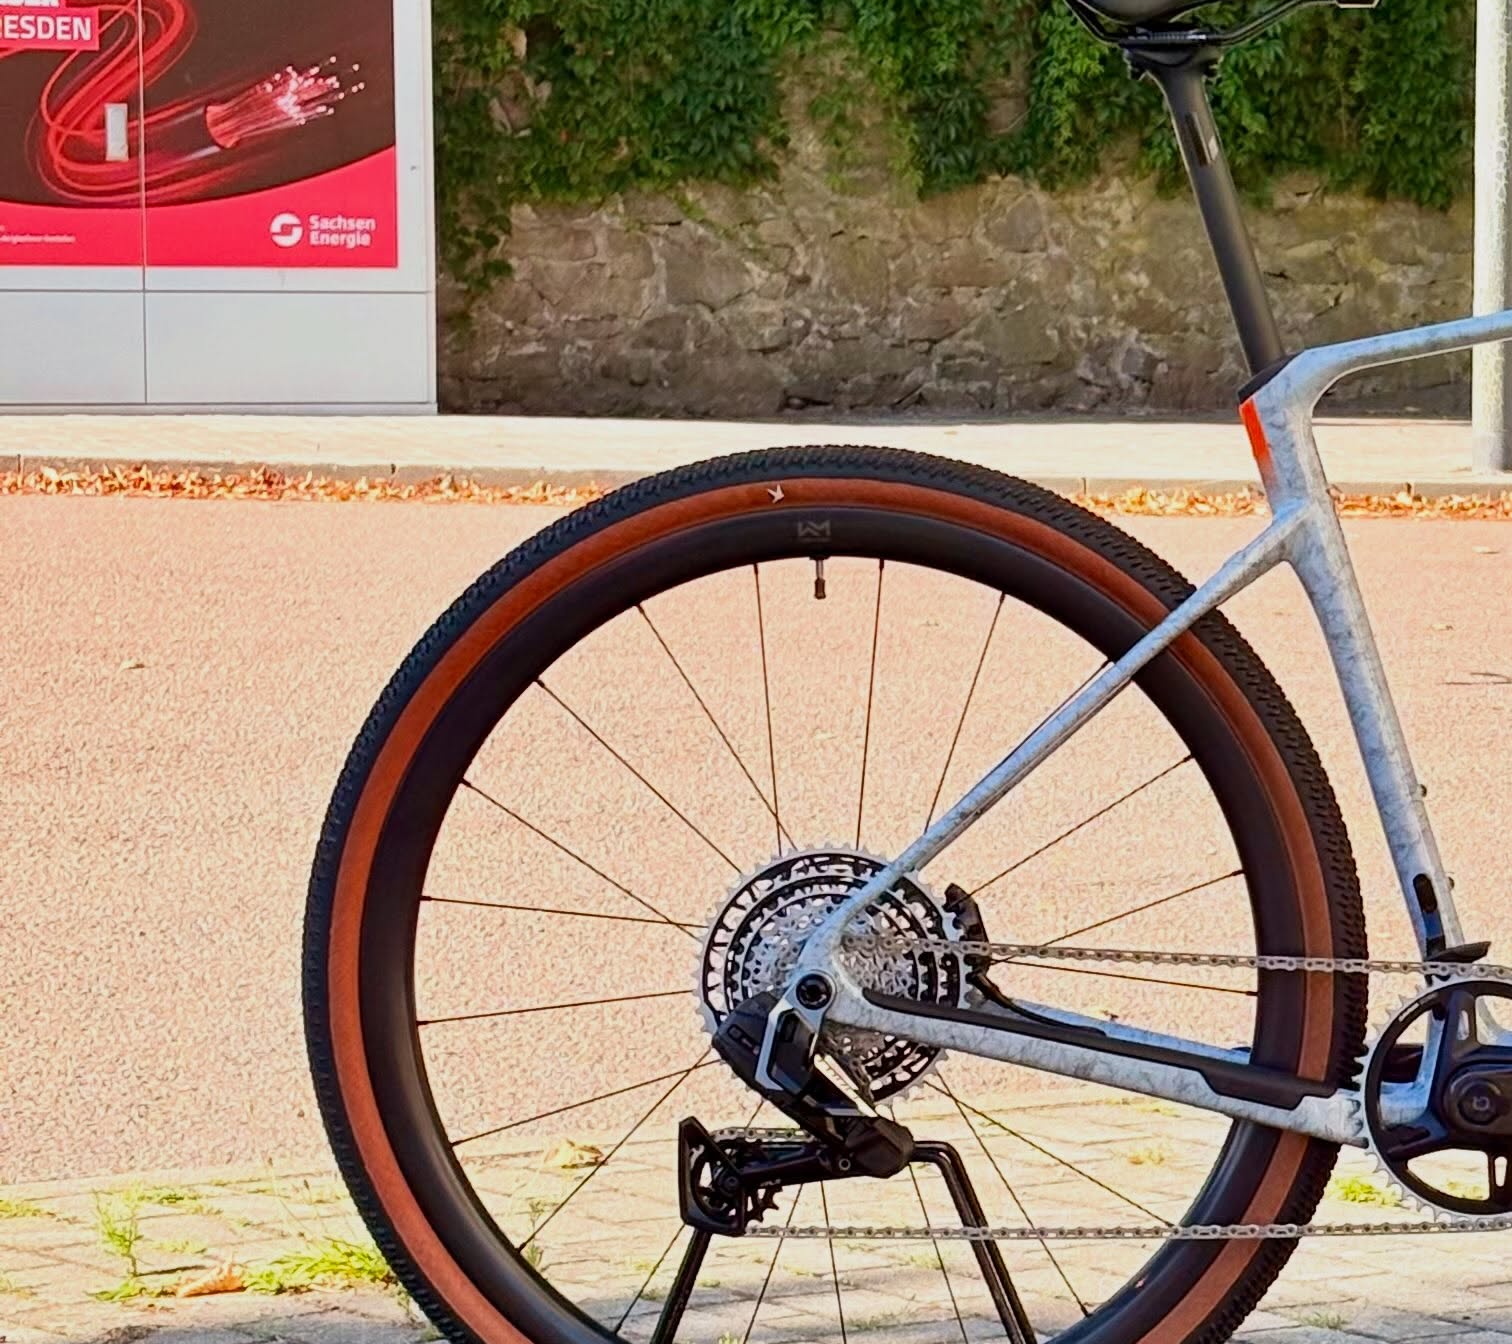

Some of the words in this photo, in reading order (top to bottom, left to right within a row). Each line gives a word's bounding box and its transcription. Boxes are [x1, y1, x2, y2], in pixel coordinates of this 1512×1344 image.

[0, 15, 92, 41] ESDEN
[309, 215, 376, 231] Sachsen
[309, 230, 371, 249] Energie
